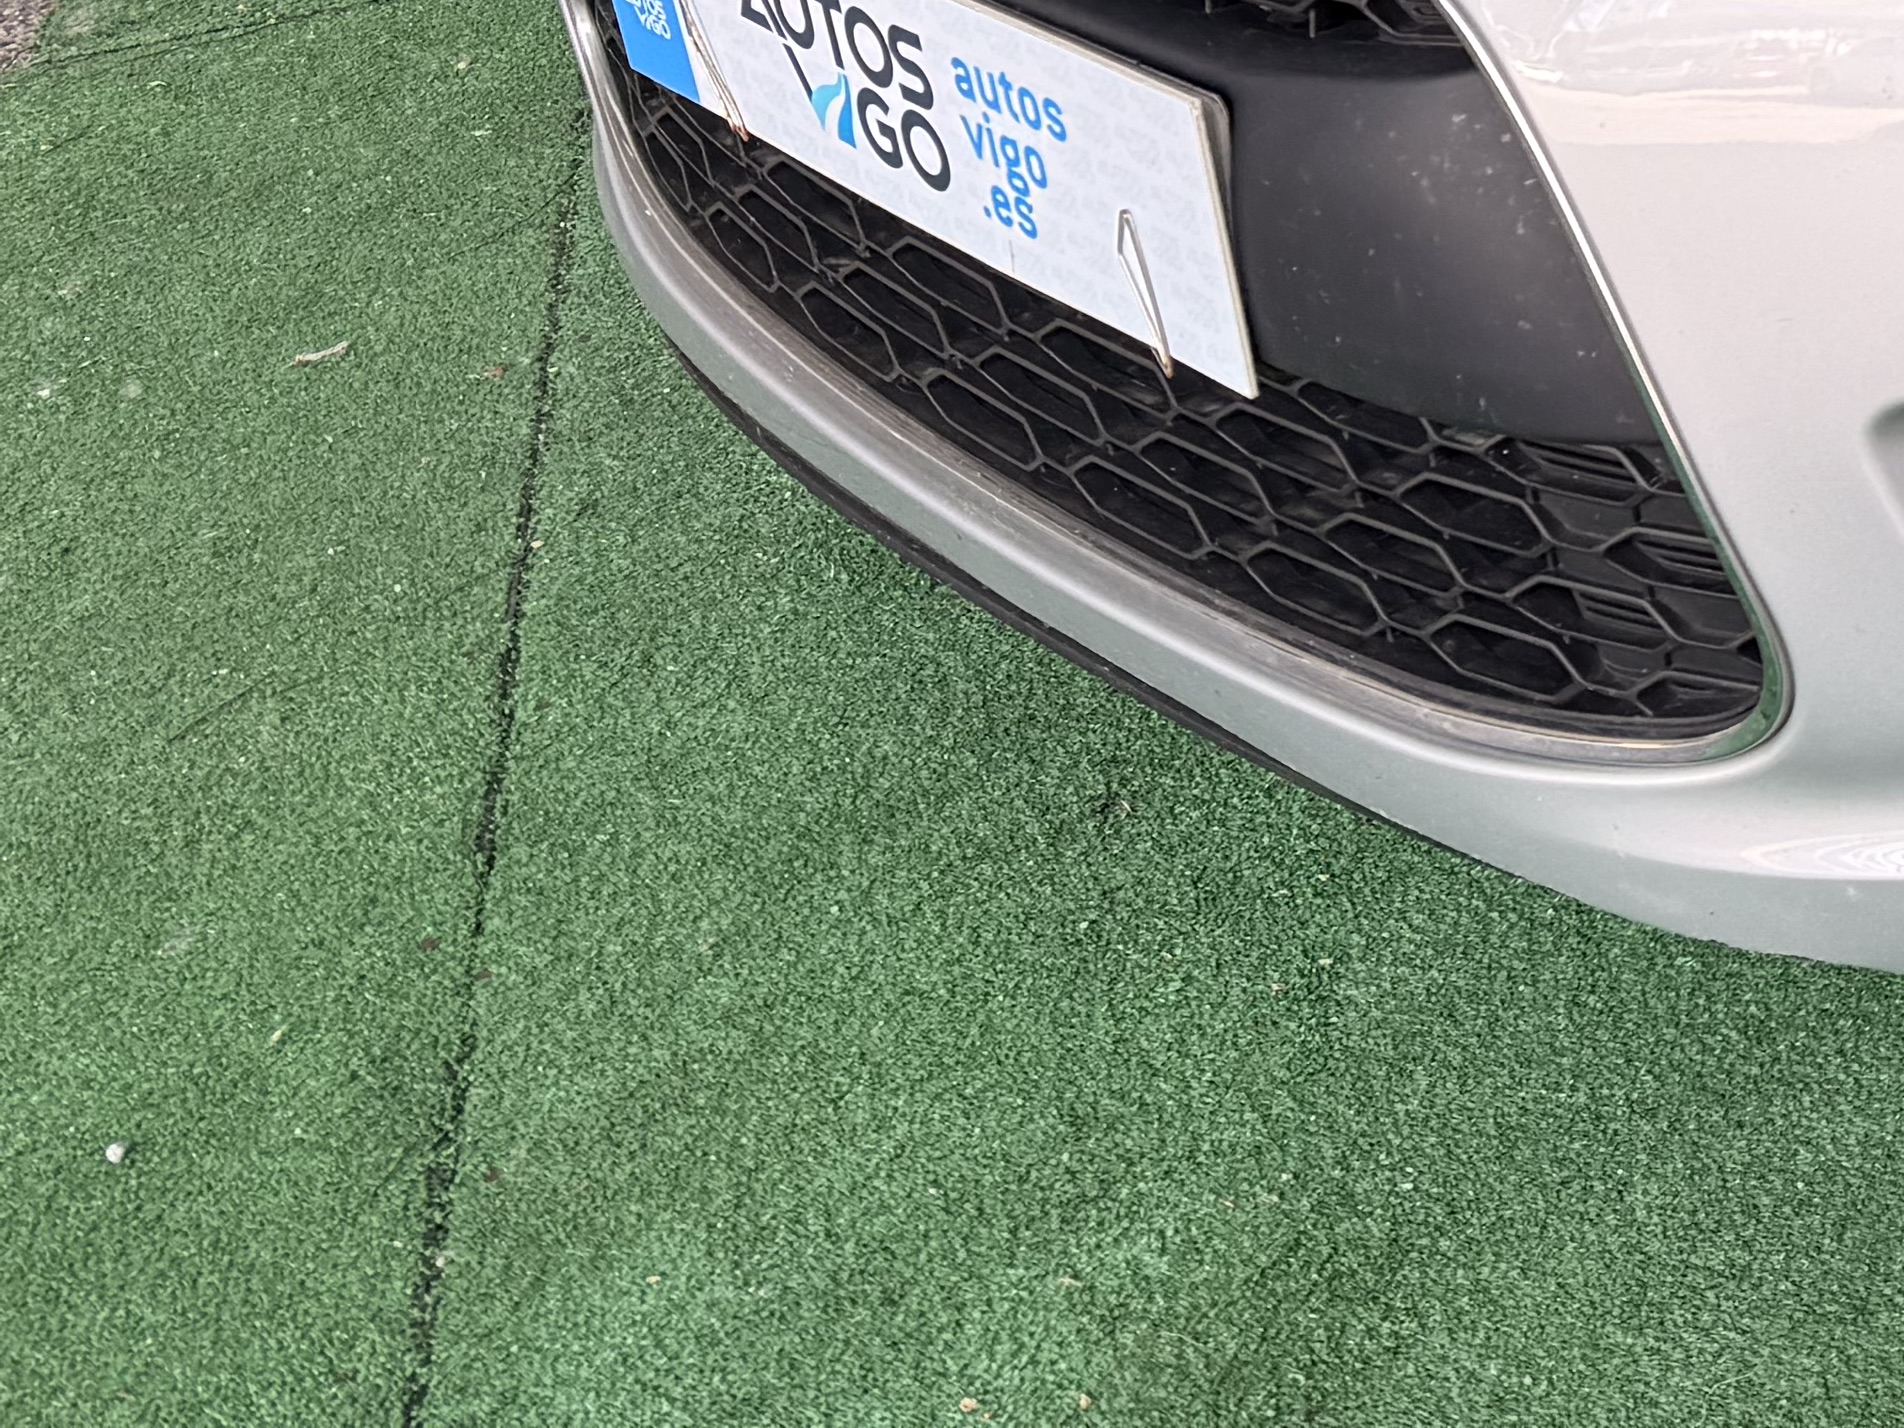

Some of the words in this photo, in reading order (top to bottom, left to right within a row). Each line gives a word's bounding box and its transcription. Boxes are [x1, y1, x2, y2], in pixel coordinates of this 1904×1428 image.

[783, 42, 951, 192] VIGO
[951, 56, 1067, 142] autos
[959, 112, 1048, 199] vigo
[984, 184, 1038, 240] .es
